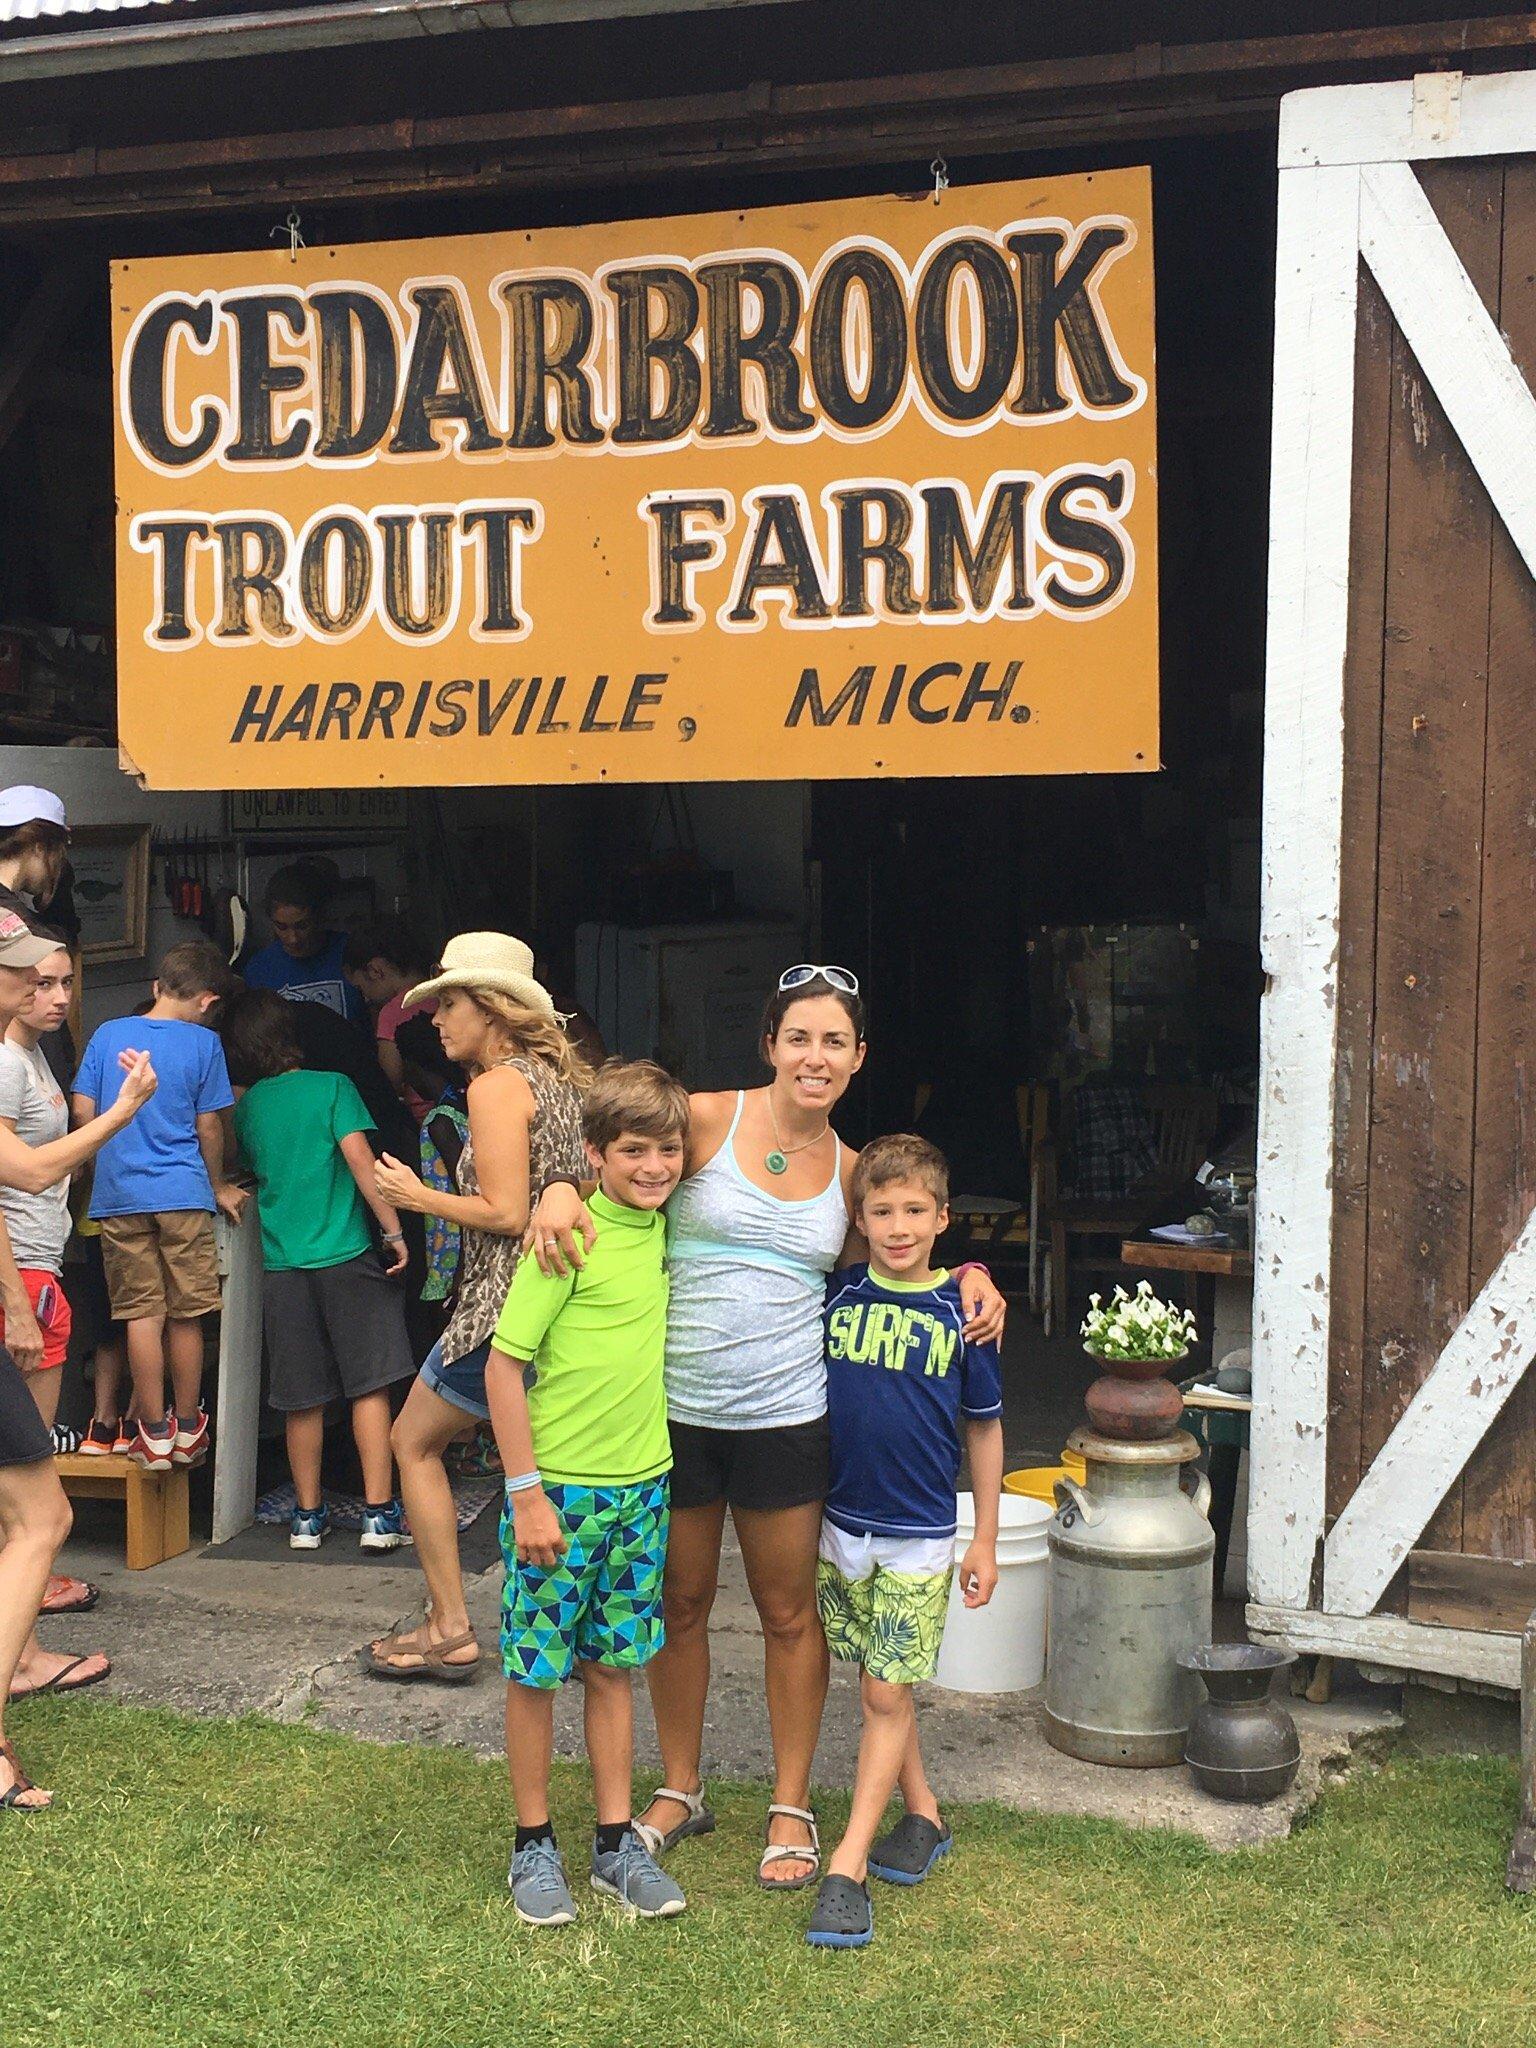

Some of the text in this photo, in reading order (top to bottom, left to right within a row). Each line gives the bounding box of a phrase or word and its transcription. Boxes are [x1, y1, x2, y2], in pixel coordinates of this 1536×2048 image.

[126, 224, 1138, 468] CEDARBROOK
[136, 468, 1129, 642] TROUT FARMS
[784, 661, 1031, 728] MICH.
[242, 790, 325, 816] UNLAWFUL
[334, 789, 350, 814] TO
